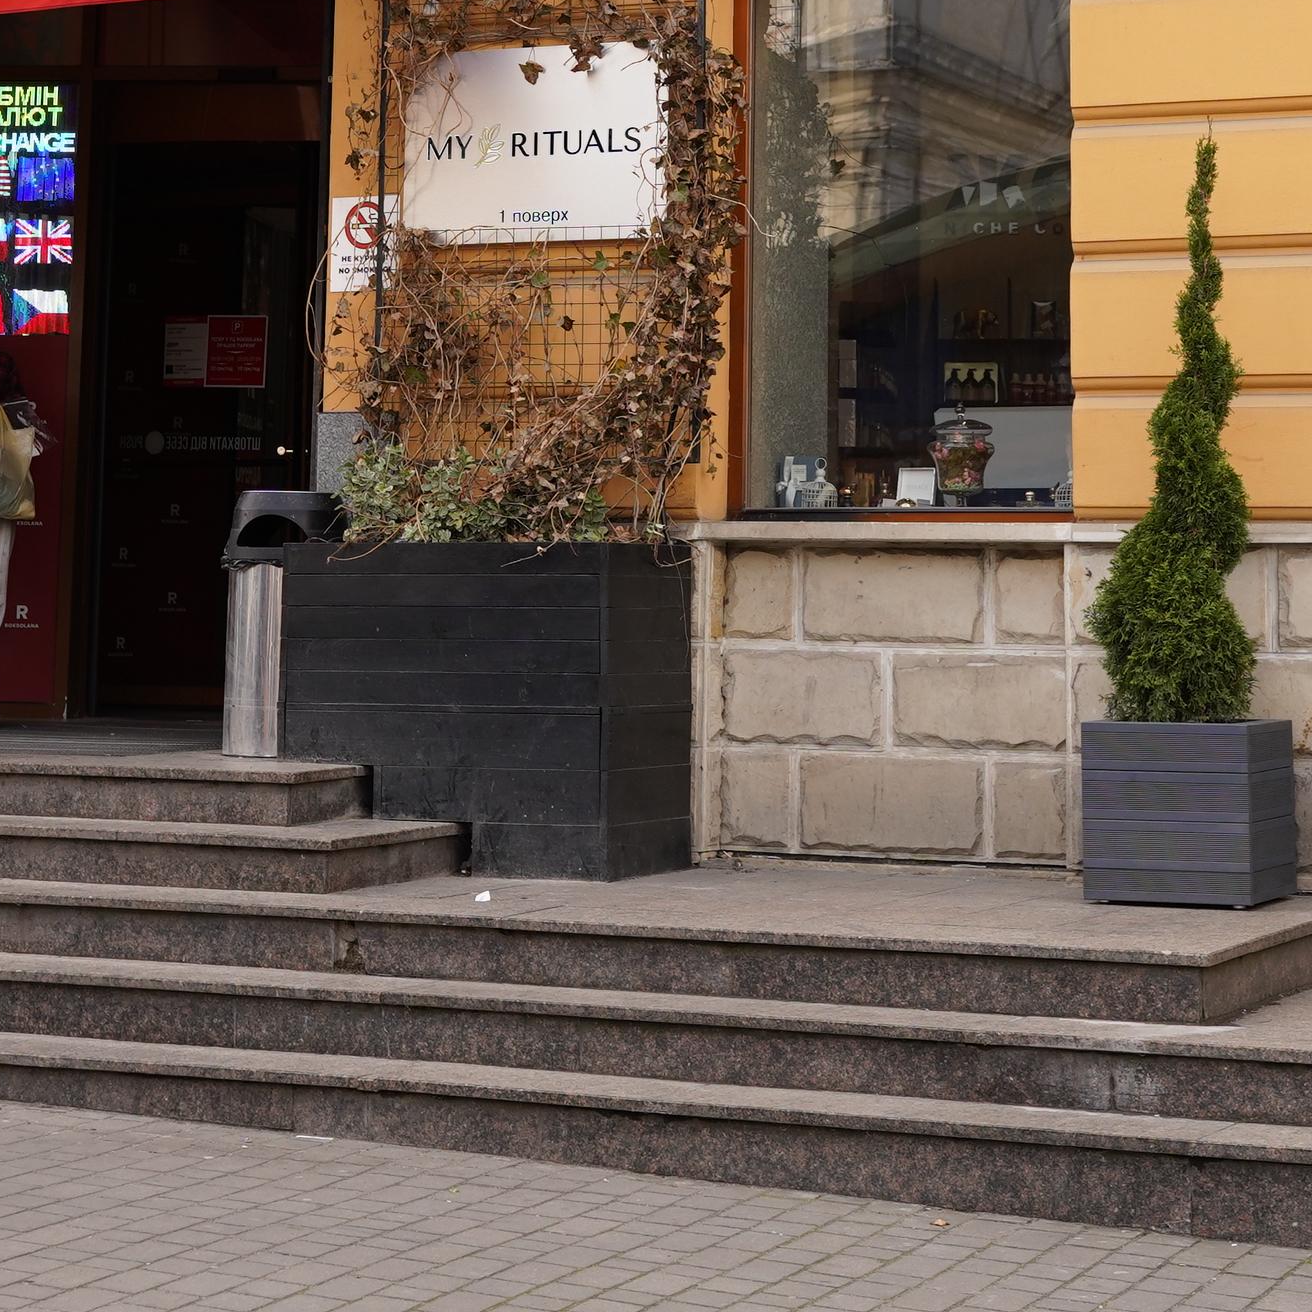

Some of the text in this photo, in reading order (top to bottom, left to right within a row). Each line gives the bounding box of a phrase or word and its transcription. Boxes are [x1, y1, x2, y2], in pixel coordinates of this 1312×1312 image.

[427, 126, 641, 161] MY RITUALS
[499, 207, 569, 226] 1 поверх
[341, 255, 352, 263] НЕ
